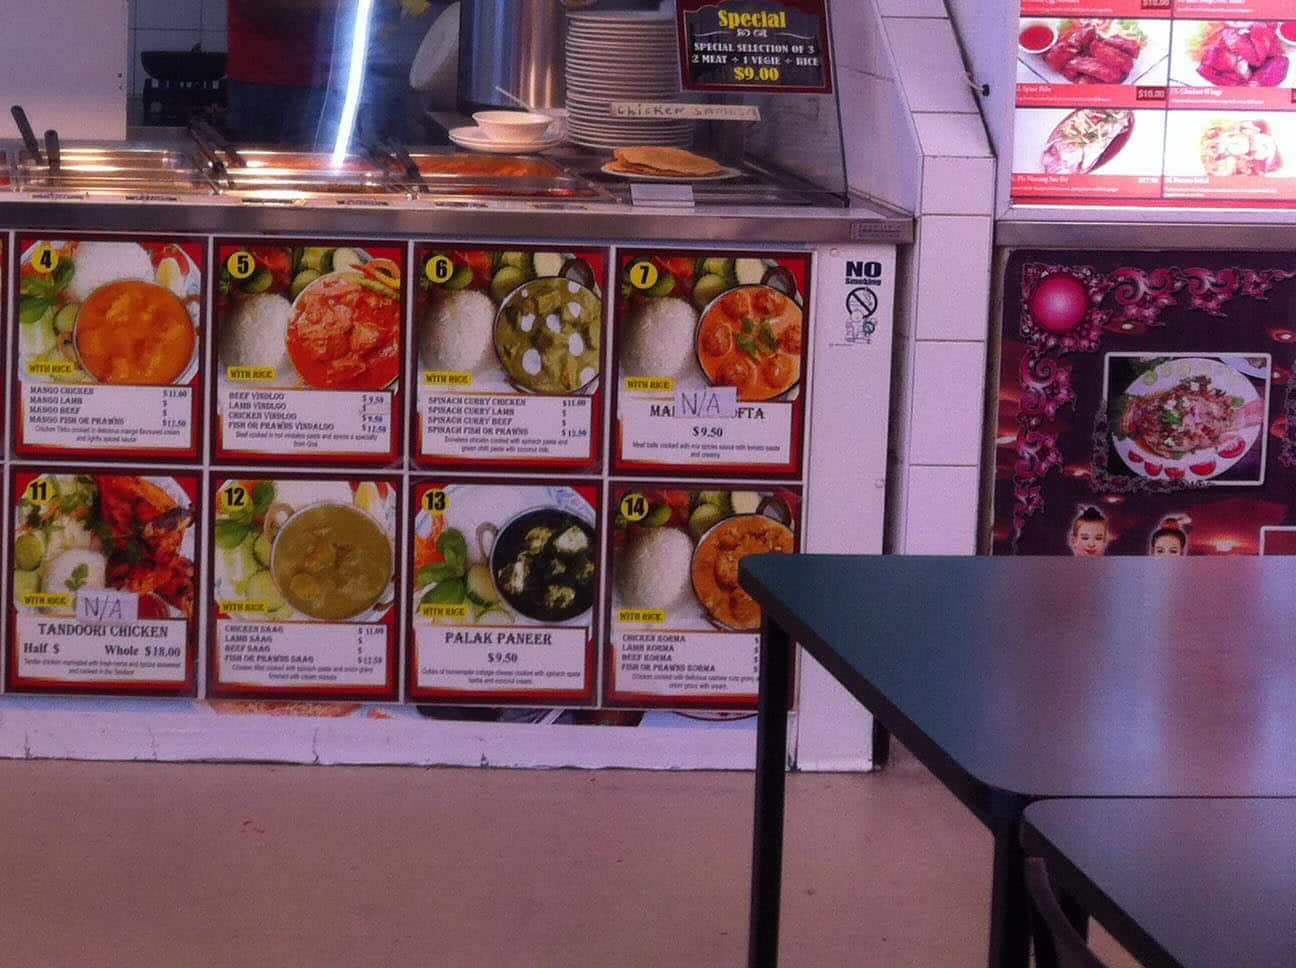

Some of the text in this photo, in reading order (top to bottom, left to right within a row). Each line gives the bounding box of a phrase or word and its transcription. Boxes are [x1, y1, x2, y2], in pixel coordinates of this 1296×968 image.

[718, 10, 787, 30] Special
[694, 42, 815, 54] SPECIAL SELECTION OF 3
[691, 54, 700, 64] 2
[701, 55, 728, 64] MEAT
[751, 56, 781, 65] VEGIE
[796, 56, 820, 66] RICE
[734, 66, 780, 82] $9.00
[40, 249, 51, 269] 4
[237, 254, 249, 274] 5
[435, 259, 447, 279] 6
[639, 265, 649, 284] 7
[846, 261, 882, 278] NO
[428, 397, 462, 406] SPINACH
[463, 397, 491, 406] CURRY
[492, 397, 526, 406] CHICKEN
[681, 390, 721, 417] N/A
[428, 406, 515, 416] SPINACH CURRY LAMB
[427, 416, 513, 425] SPINACH CURRY BEEF
[427, 426, 461, 435] SPINACH
[463, 426, 481, 435] FISH
[482, 427, 493, 435] OR
[494, 427, 528, 436] PRAWNS
[692, 426, 724, 438] $9.50
[30, 481, 47, 501] 11
[224, 487, 245, 506] 12
[426, 491, 445, 510] 13
[625, 496, 645, 516] 14
[83, 596, 123, 620] N/A
[37, 623, 169, 637] TANDOORI CHICKEN
[444, 631, 552, 645] PALAK PANEER
[23, 642, 49, 654] Half
[104, 644, 139, 656] Whole
[487, 652, 518, 664] $9.50
